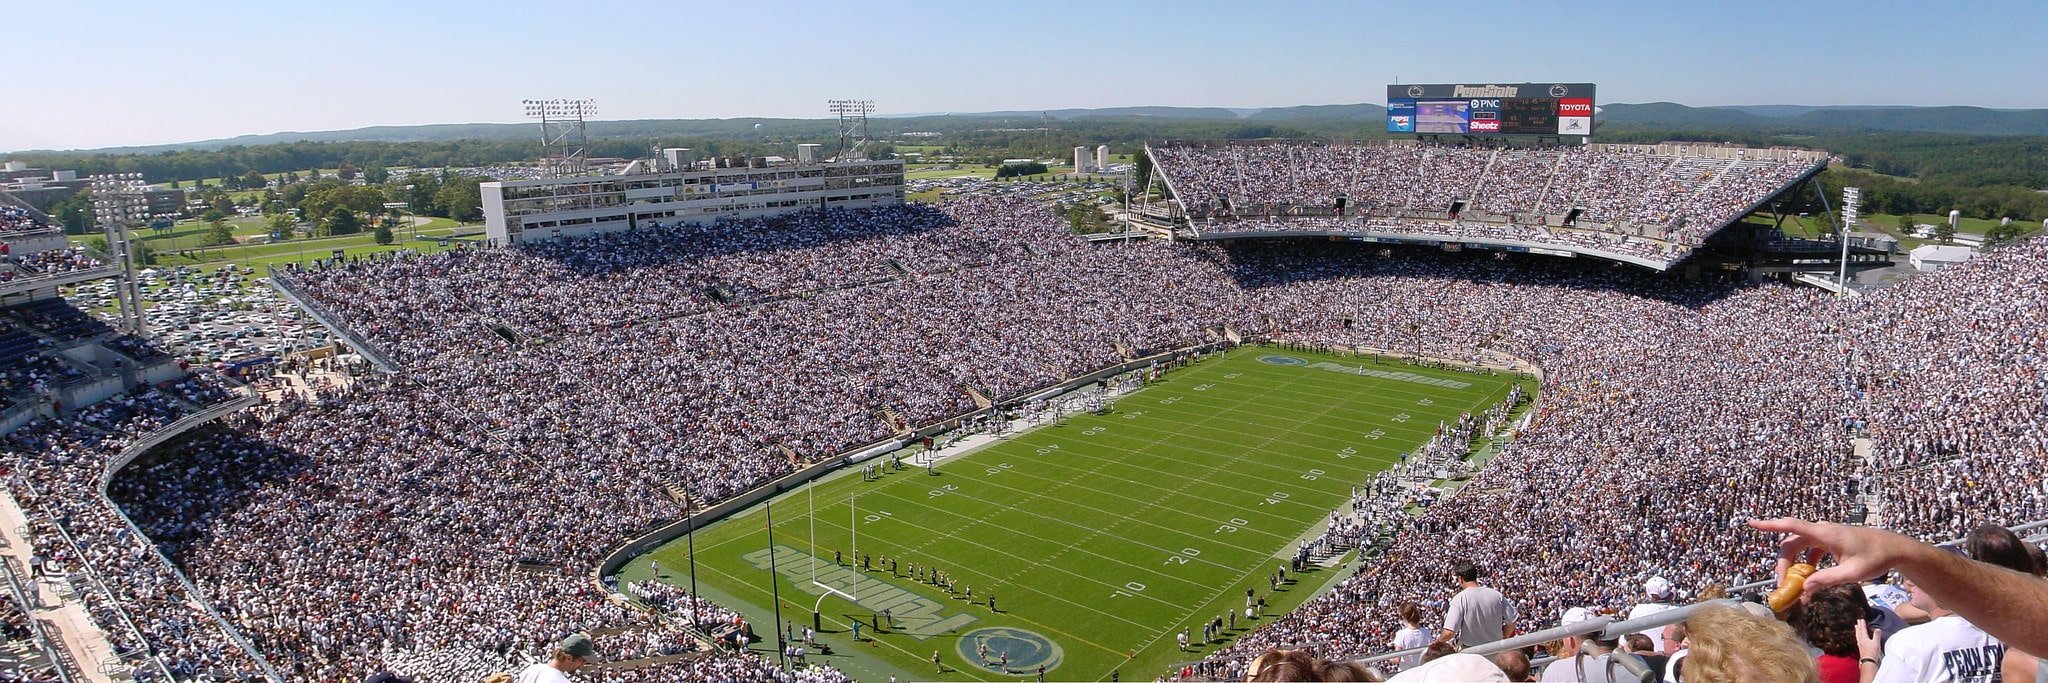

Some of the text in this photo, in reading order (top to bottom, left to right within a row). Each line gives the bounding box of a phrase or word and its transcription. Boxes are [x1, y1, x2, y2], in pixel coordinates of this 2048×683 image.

[1453, 84, 1518, 98] PennState
[1480, 100, 1500, 108] PNC
[1470, 121, 1499, 130] Sheetz
[1365, 430, 1385, 440] 30
[1301, 469, 1326, 480] 50
[928, 484, 959, 497] 20
[1266, 491, 1290, 505] 40
[864, 510, 892, 522] 10
[1219, 517, 1249, 533] 30
[1169, 547, 1201, 565] 20
[1115, 582, 1147, 598] 10
[1943, 647, 1983, 681] PENN
